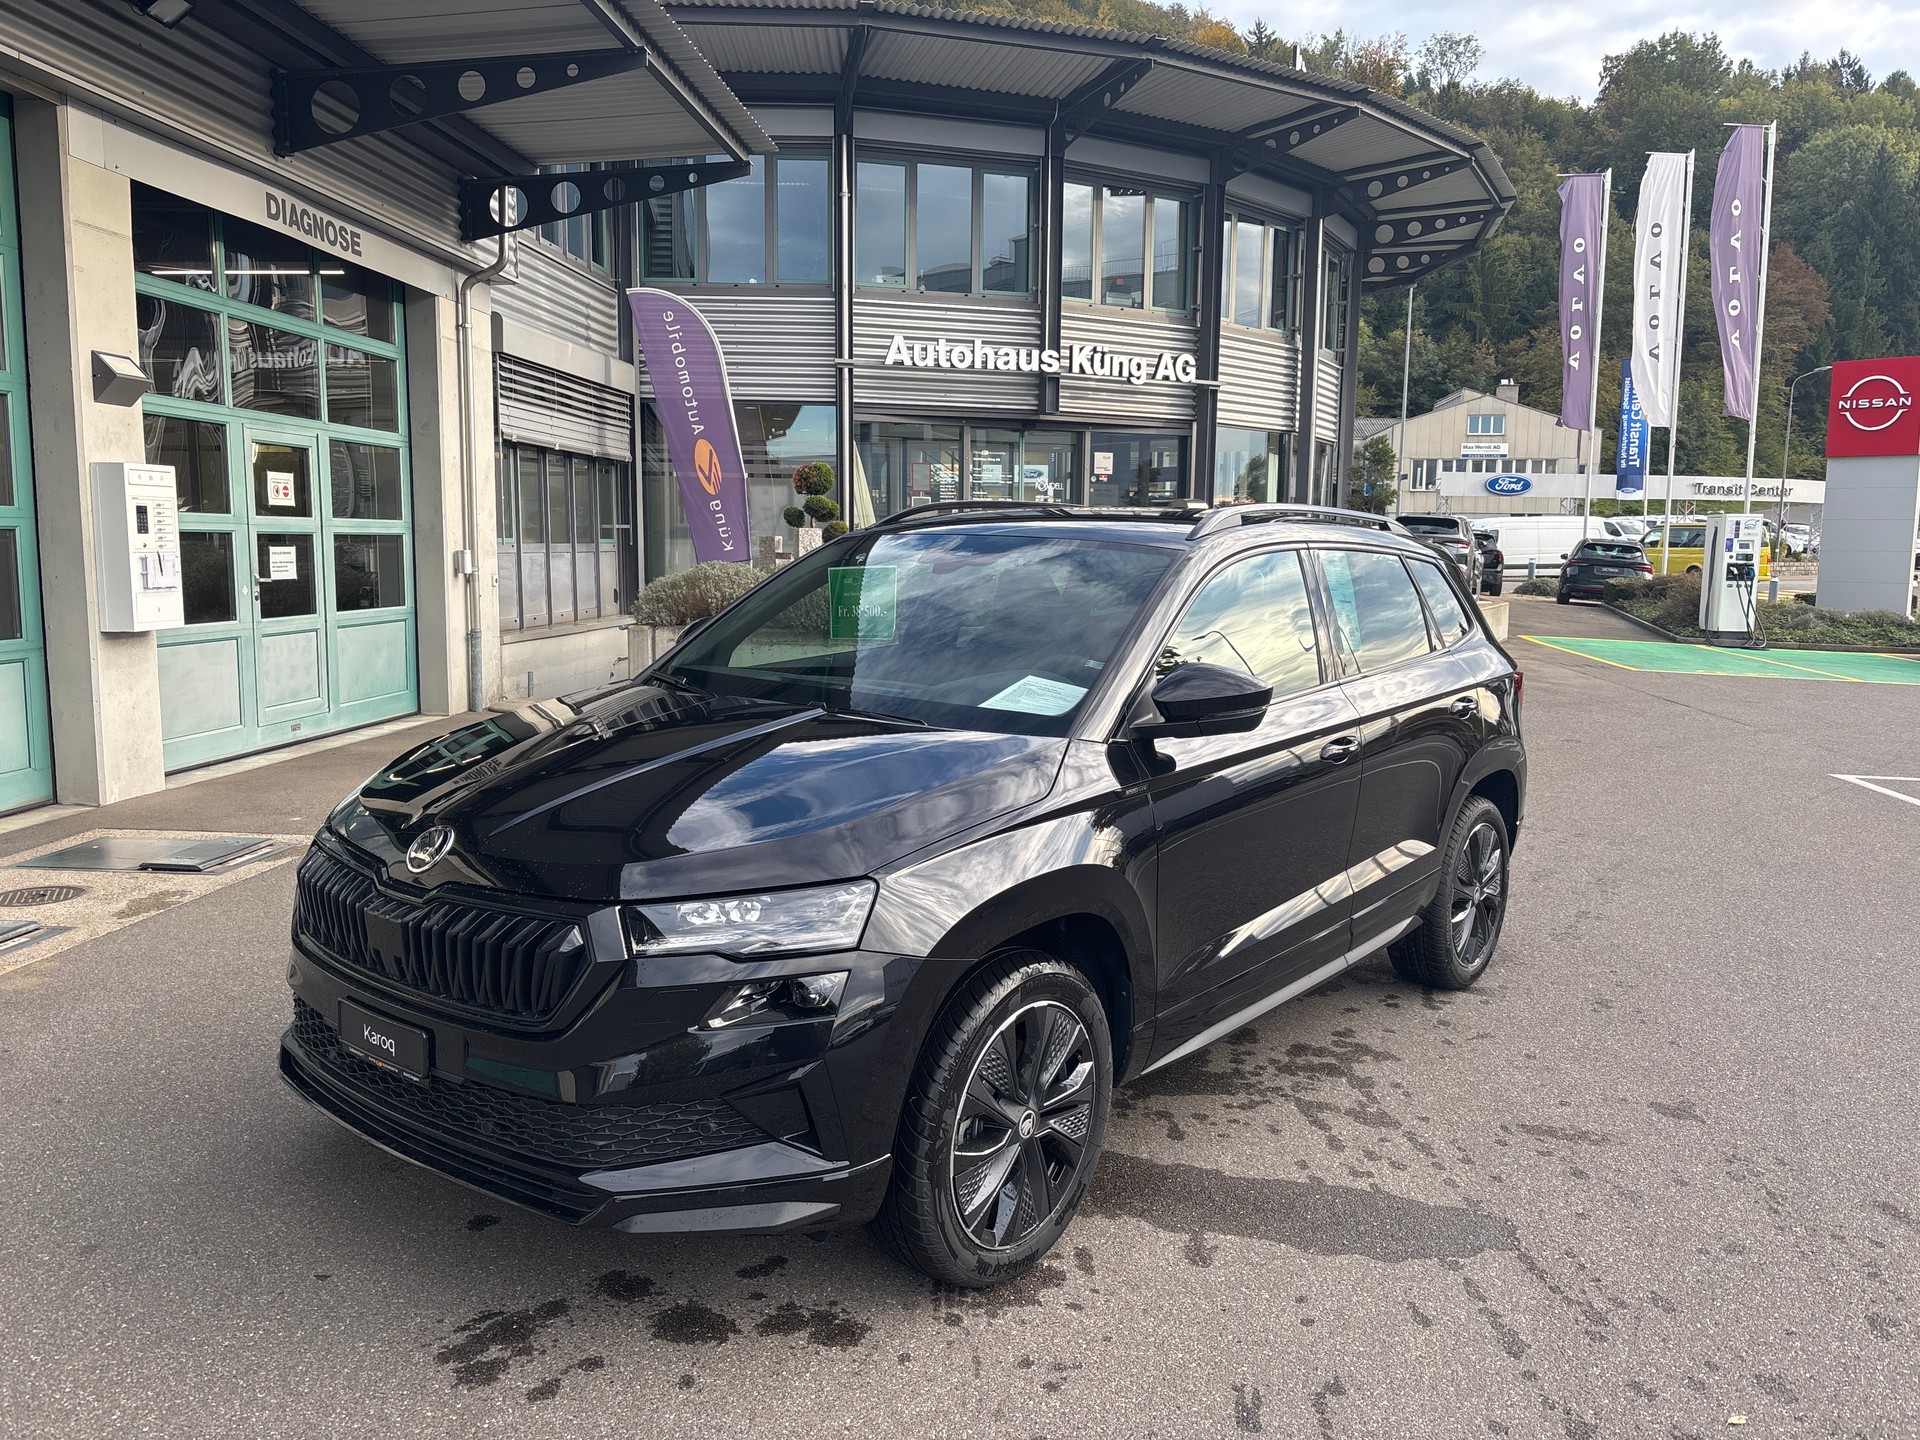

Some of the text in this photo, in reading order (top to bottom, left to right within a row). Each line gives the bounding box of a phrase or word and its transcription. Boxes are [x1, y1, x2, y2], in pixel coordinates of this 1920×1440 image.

[265, 192, 362, 257] DIAGNOSE
[884, 335, 1197, 385] Autohaus Küng AG
[1838, 396, 1912, 410] NISSAN
[1494, 477, 1524, 491] Ford
[1693, 482, 1794, 497] Transit Center
[838, 605, 850, 617] Fr.
[363, 1023, 396, 1057] Karoq
